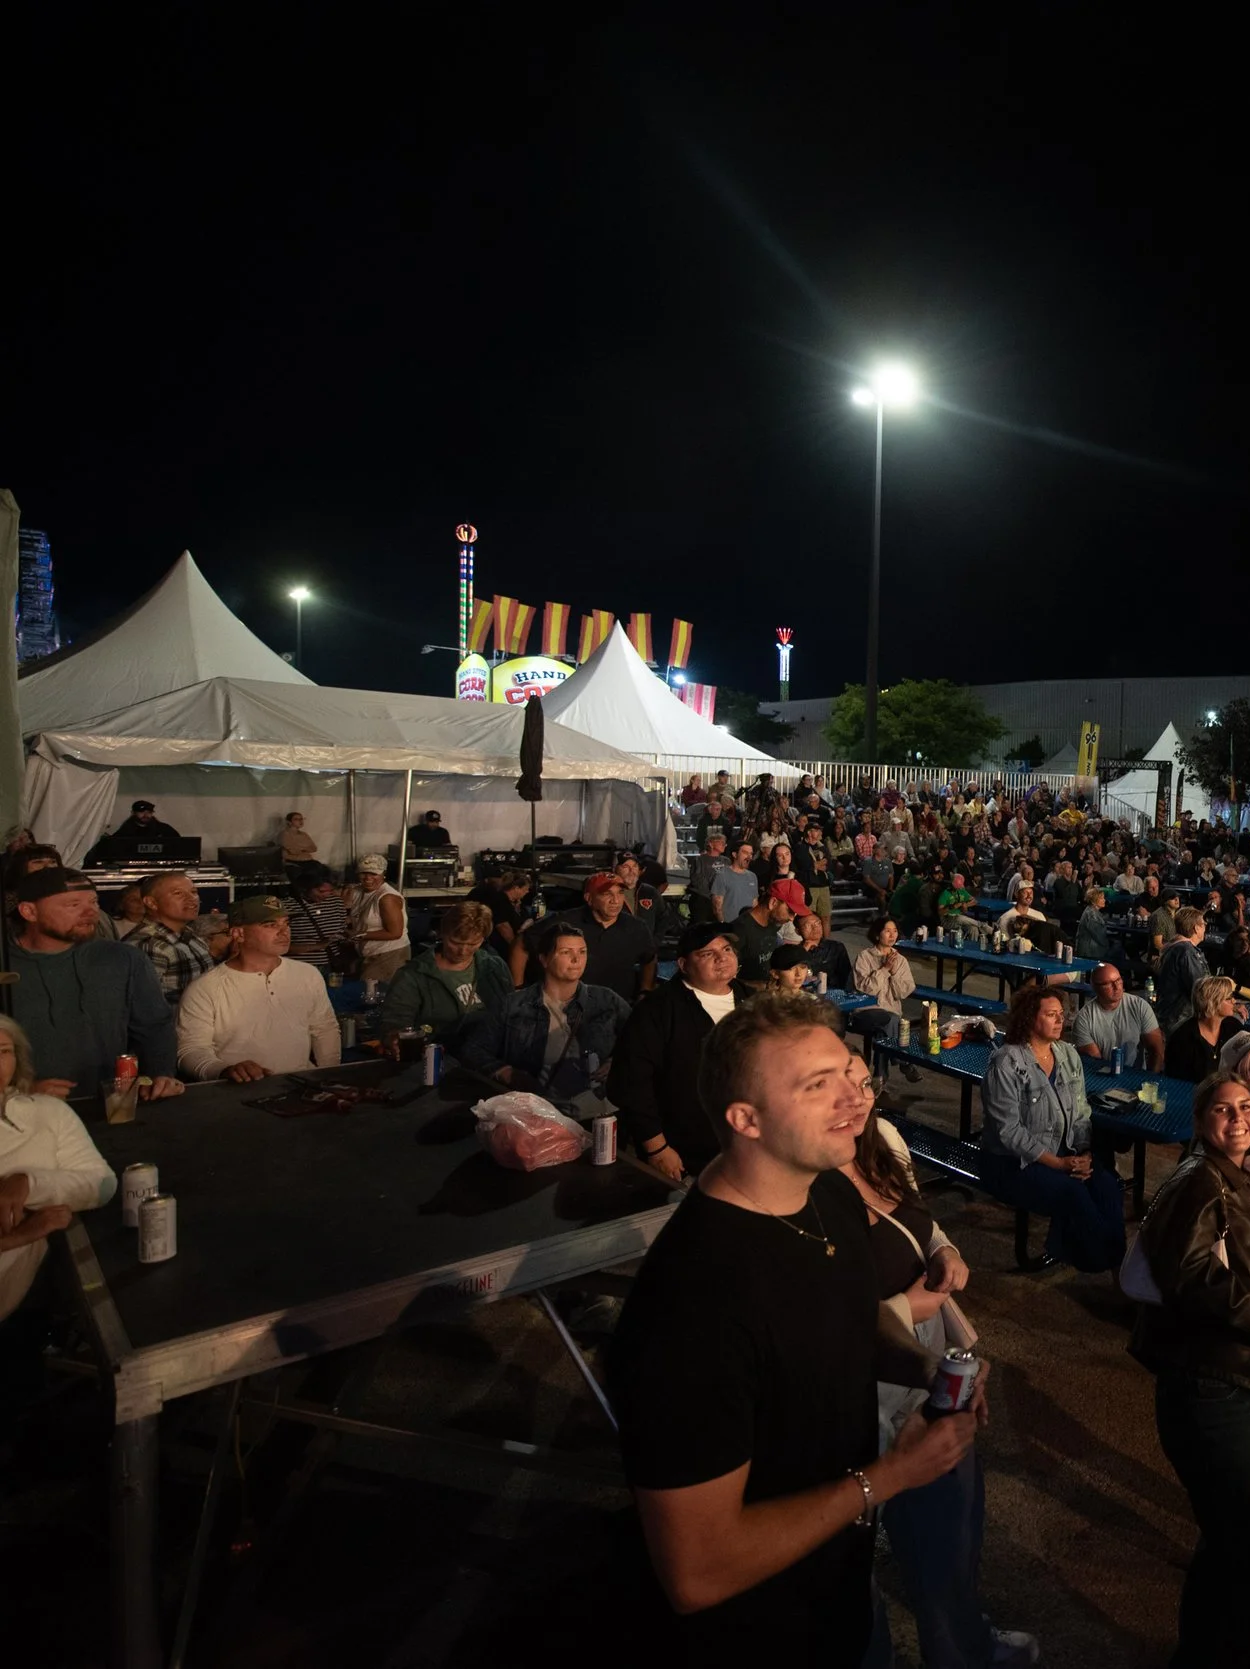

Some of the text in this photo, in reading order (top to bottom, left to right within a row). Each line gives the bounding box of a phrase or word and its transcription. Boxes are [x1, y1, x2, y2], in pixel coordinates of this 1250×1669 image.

[515, 670, 566, 683] HAND
[458, 677, 486, 693] CORN
[505, 685, 556, 704] CO
